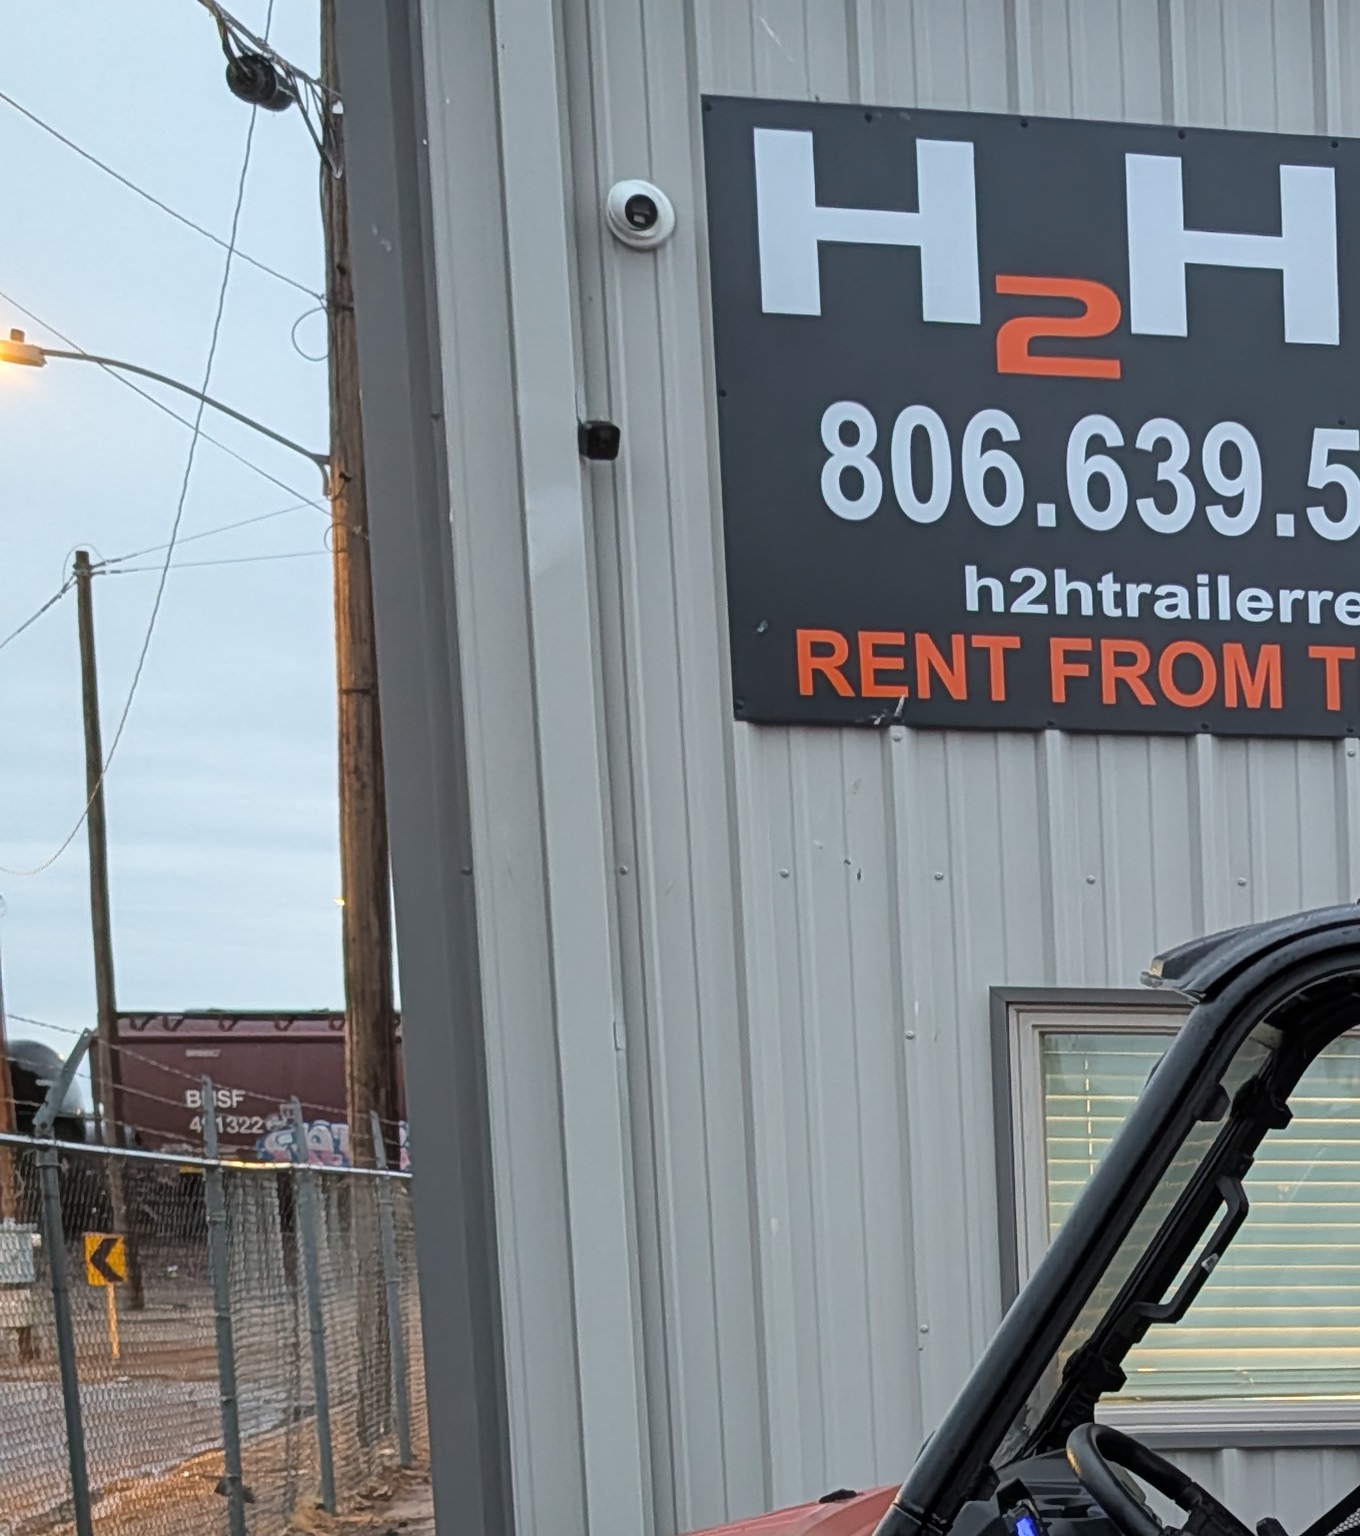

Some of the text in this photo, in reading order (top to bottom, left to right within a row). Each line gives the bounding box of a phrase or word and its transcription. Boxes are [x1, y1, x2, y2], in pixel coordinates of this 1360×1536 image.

[753, 127, 1340, 379] H2H
[796, 628, 1020, 703] RENT
[1050, 636, 1284, 711] FROM
[189, 1116, 264, 1134] 41322
